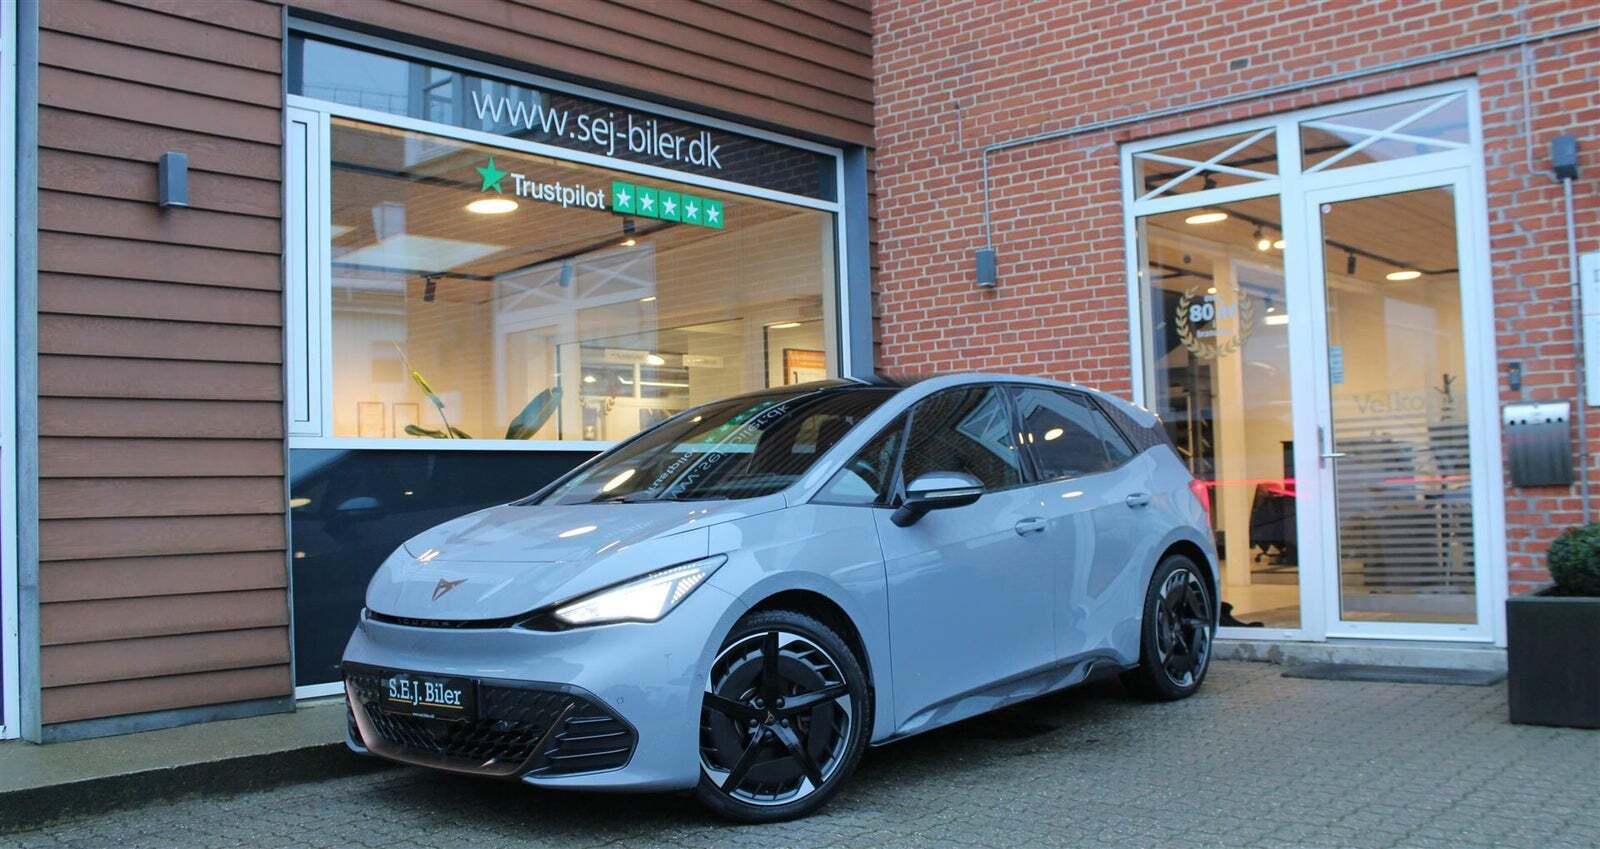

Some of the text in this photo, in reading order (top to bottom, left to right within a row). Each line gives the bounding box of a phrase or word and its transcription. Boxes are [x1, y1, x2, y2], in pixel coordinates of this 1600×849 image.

[471, 90, 722, 170] www.sej-biler.dk
[510, 172, 606, 210] Trustpilot
[1189, 303, 1214, 322] 80
[389, 678, 462, 706] S.E.J. Biler
